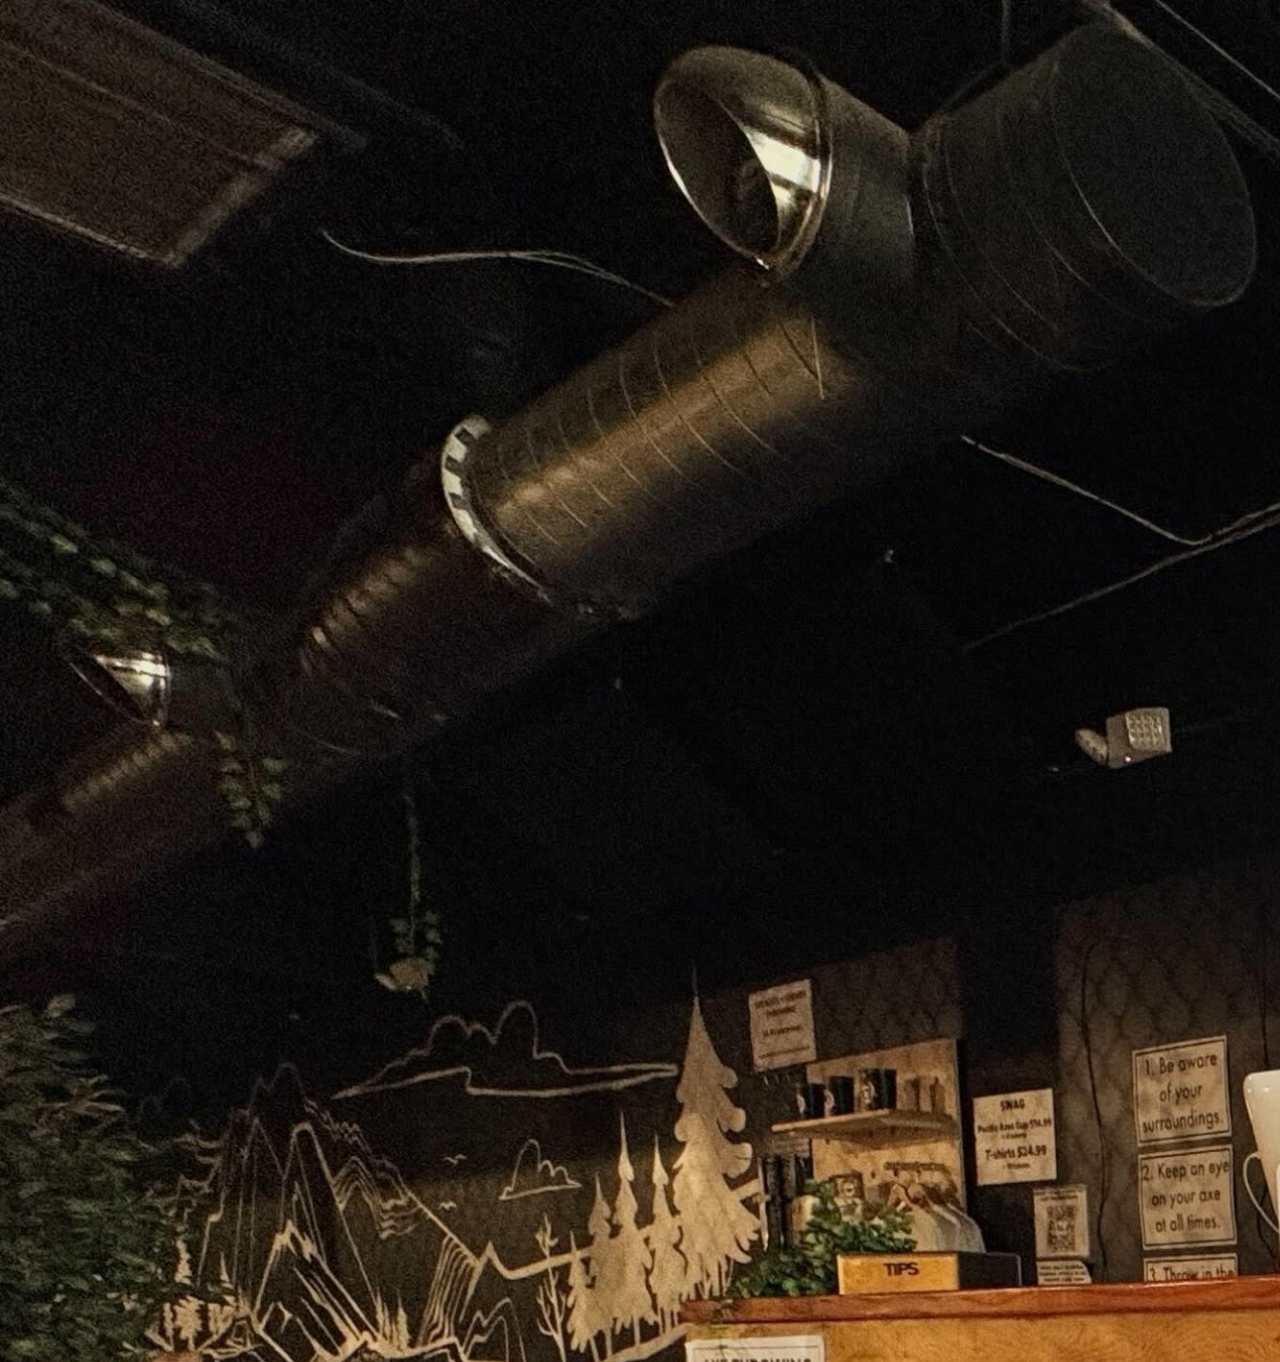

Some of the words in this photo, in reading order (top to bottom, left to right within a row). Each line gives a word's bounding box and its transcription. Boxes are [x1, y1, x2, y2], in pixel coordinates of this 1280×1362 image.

[1159, 1057, 1175, 1074] Be
[1178, 1053, 1218, 1073] aware
[1159, 1082, 1174, 1101] of
[1175, 1085, 1203, 1105] your
[1000, 1098, 1026, 1112] SWAG
[1142, 1110, 1224, 1134] surroundings.
[1158, 1162, 1187, 1183] Keep
[1209, 1160, 1230, 1178] eye
[1151, 1193, 1167, 1207] on
[1169, 1192, 1197, 1210] your
[1200, 1188, 1221, 1201] axe
[1155, 1219, 1167, 1233] at
[1169, 1214, 1185, 1233] all
[1187, 1215, 1221, 1230] times.
[883, 1261, 920, 1276] TIPS
